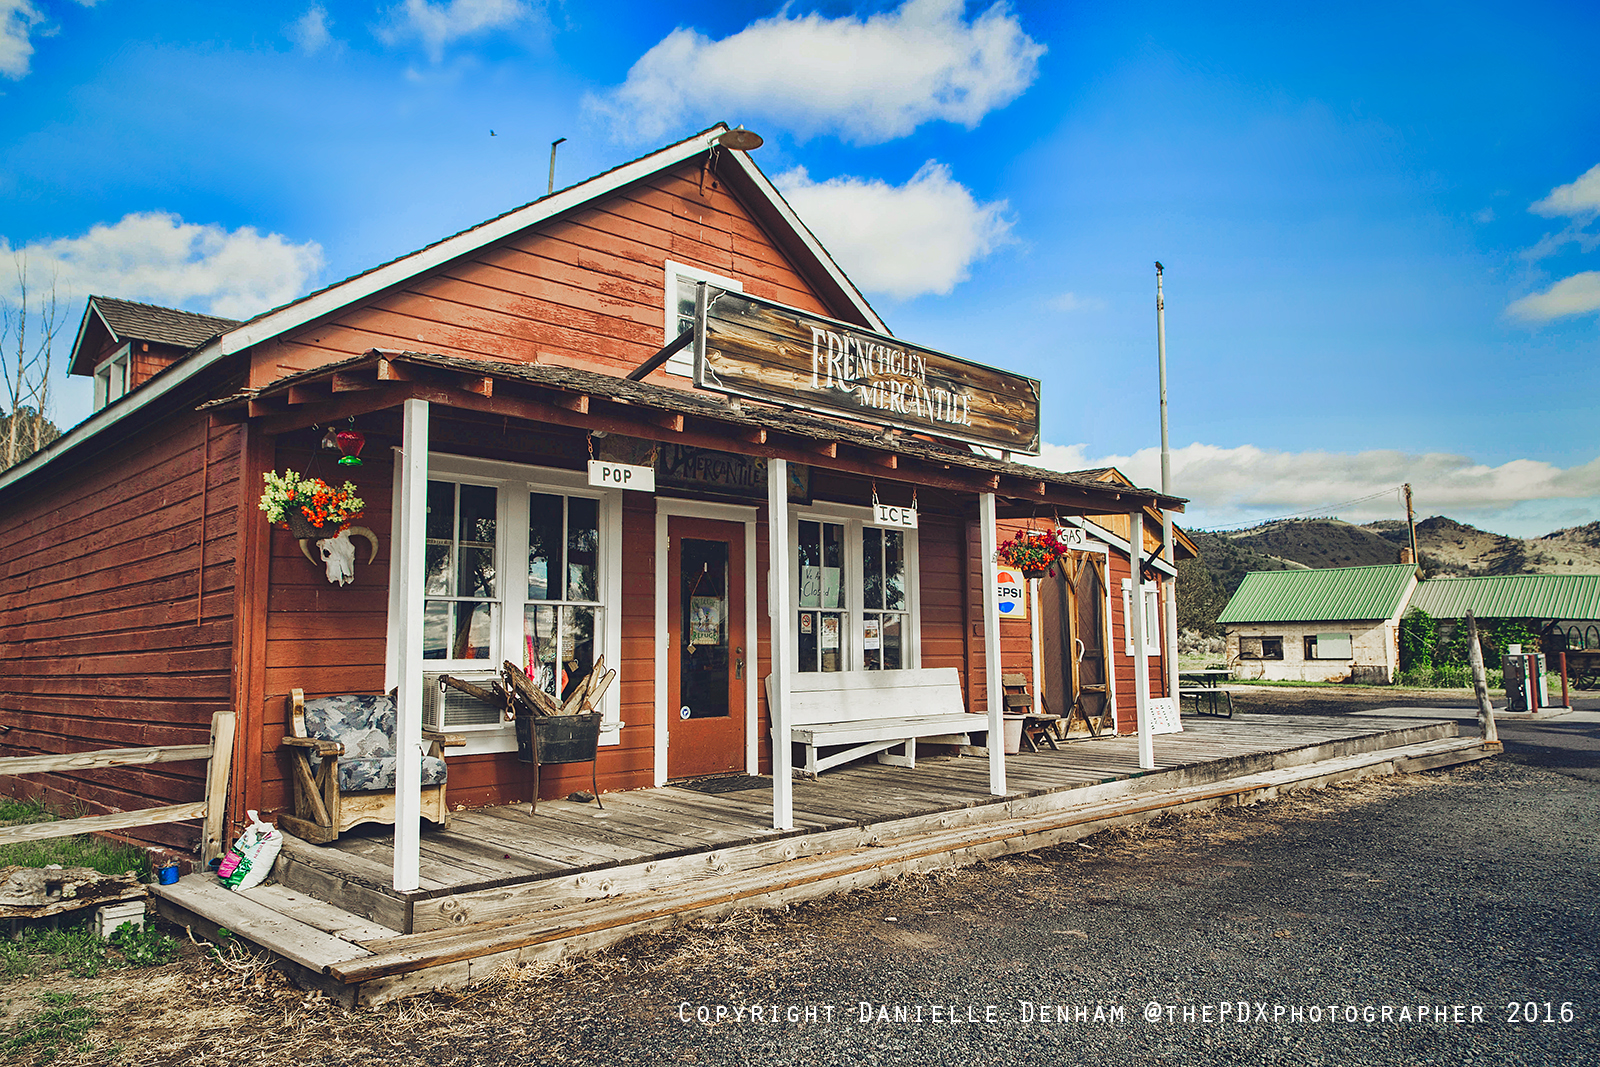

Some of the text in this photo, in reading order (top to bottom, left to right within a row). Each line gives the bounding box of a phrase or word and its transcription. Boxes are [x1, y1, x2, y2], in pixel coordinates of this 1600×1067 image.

[810, 326, 927, 393] FRENCHGLEN
[859, 379, 972, 427] MERCANTILE
[602, 466, 632, 483] POP
[683, 456, 761, 486] MERCANTILE
[879, 505, 912, 525] ICE
[1061, 529, 1082, 544] GAS
[803, 580, 831, 597] Closd
[997, 587, 1022, 598] EPSI
